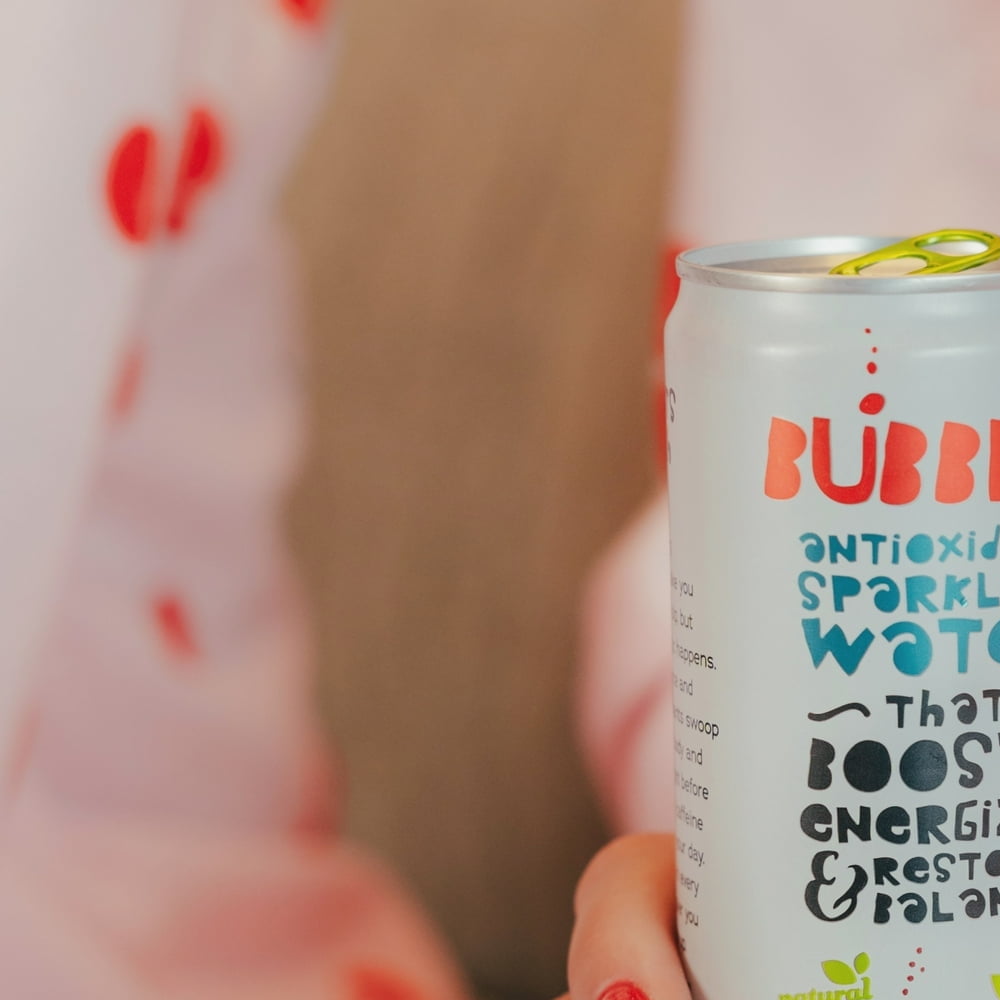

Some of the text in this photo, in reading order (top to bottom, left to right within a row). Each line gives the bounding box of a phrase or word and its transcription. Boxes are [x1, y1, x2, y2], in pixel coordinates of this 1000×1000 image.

[679, 580, 694, 598] you
[679, 608, 694, 630] but
[679, 679, 694, 696] and
[685, 715, 720, 740] swoop
[685, 747, 703, 766] and
[681, 773, 710, 800] before
[685, 908, 699, 927] you
